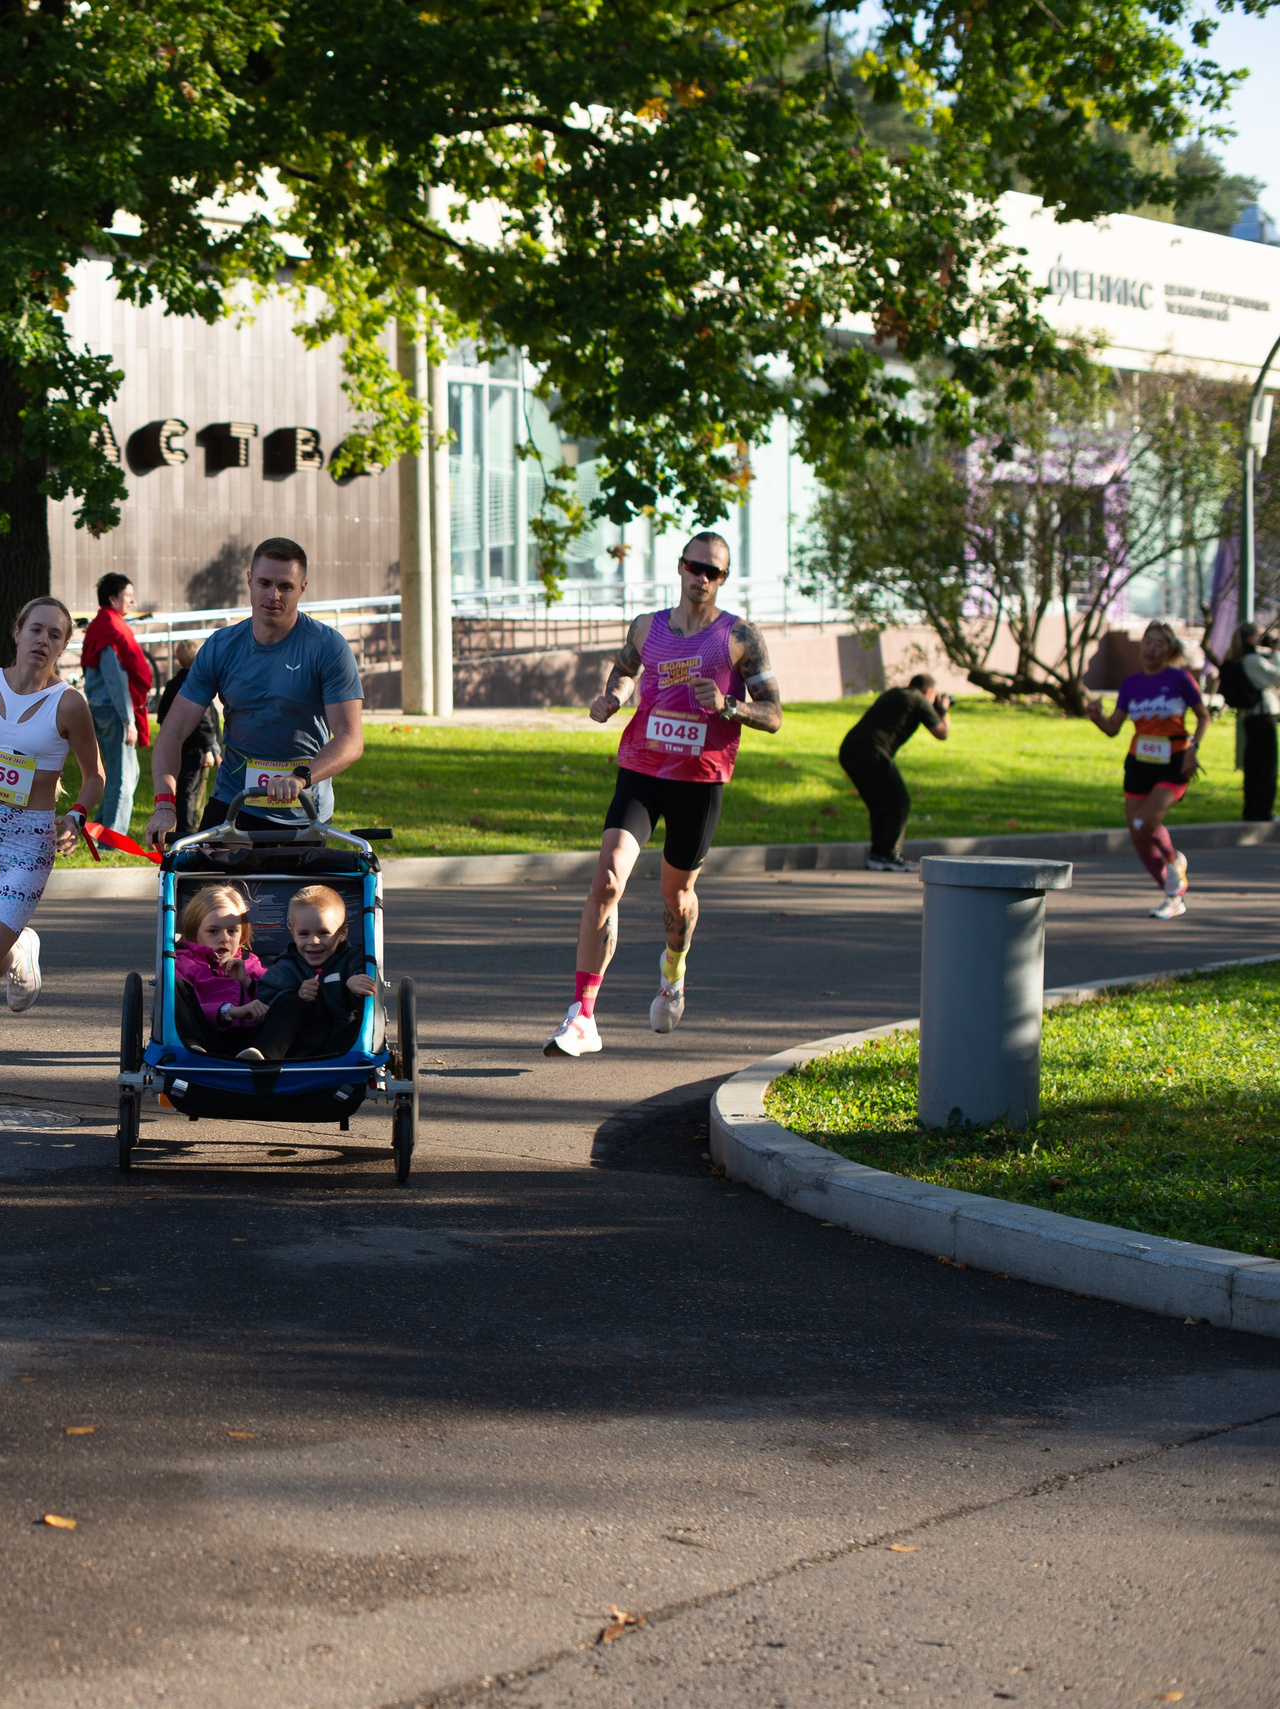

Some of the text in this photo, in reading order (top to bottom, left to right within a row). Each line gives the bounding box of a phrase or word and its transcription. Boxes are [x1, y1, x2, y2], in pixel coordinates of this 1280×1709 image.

[1048, 254, 1154, 310] ФЕНИКС
[653, 721, 699, 741] 1048
[665, 743, 672, 751] 11
